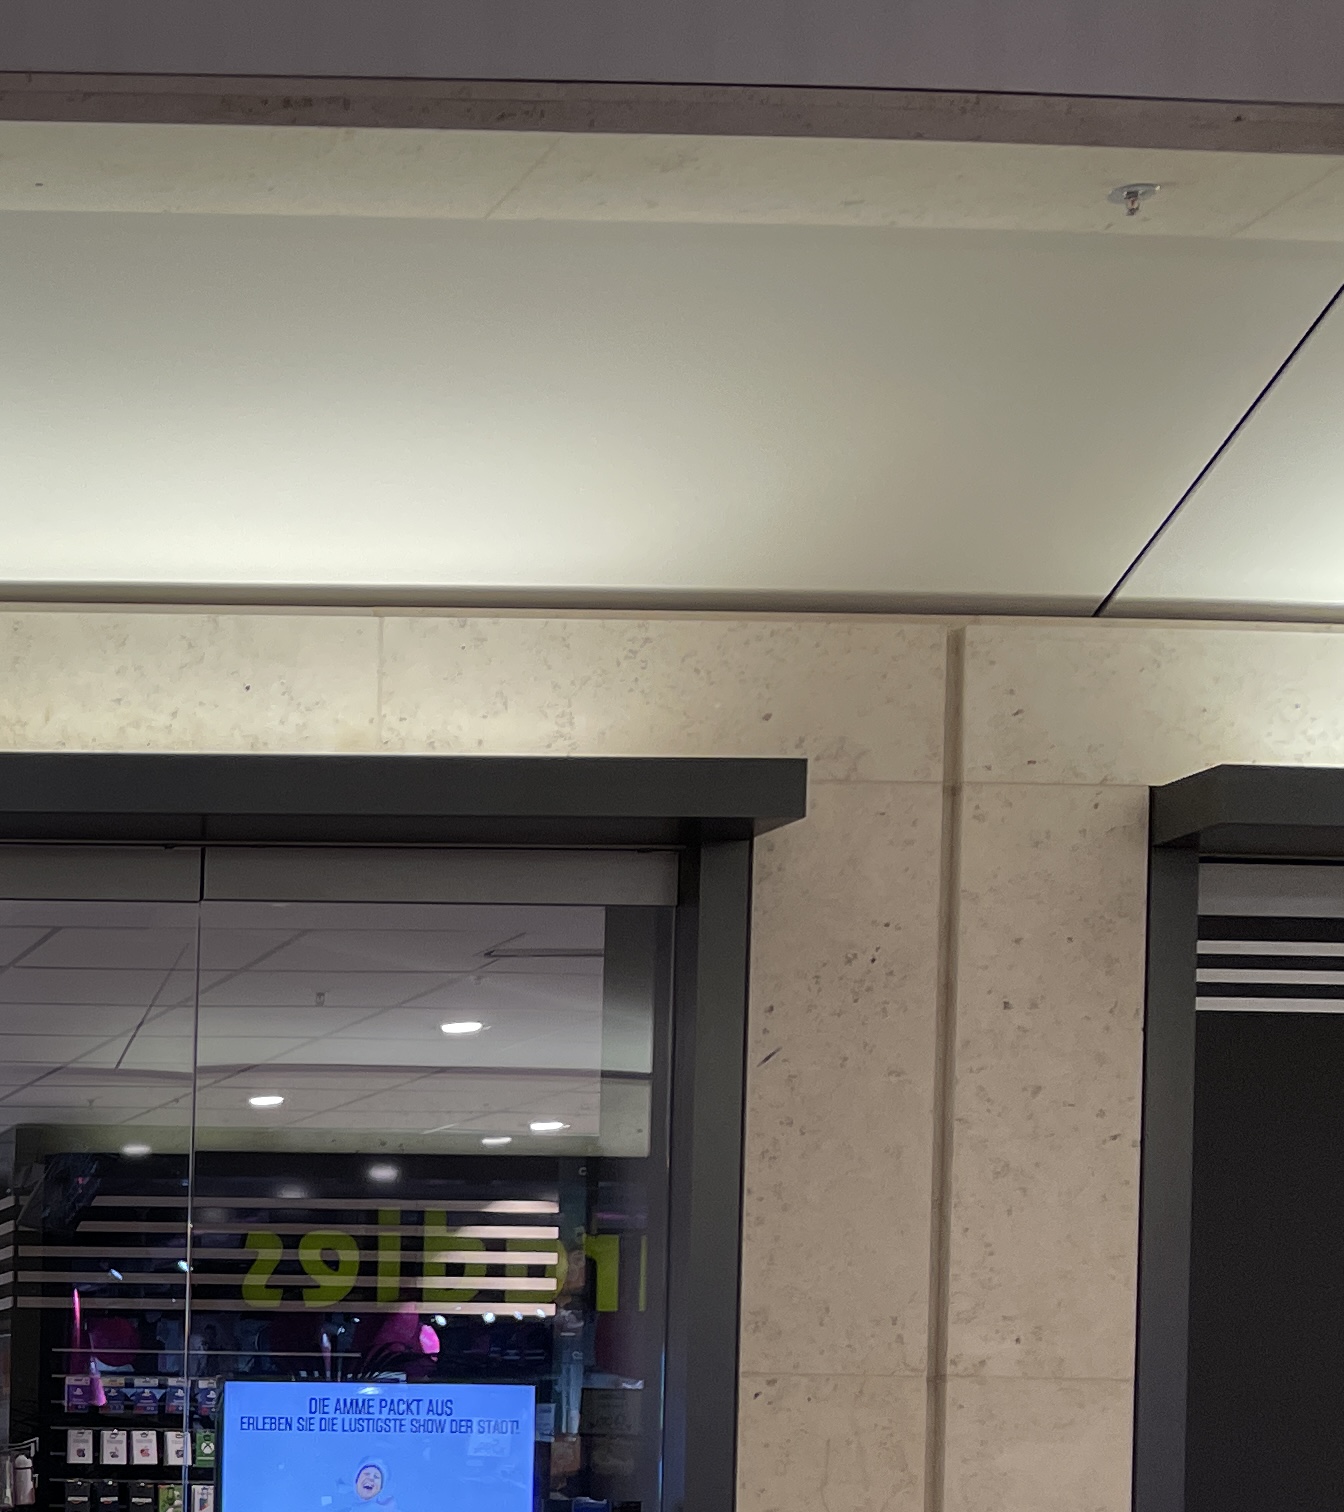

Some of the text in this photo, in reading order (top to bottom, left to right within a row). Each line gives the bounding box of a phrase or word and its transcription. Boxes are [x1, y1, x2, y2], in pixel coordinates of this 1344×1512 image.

[308, 1397, 454, 1417] DIE AMME PACKT AUS
[239, 1416, 293, 1432] ERLEBEN
[296, 1417, 316, 1433] SIE
[318, 1417, 339, 1433] DIE
[341, 1417, 406, 1434] LUSTIGSTE
[410, 1418, 447, 1434] SHOW
[449, 1418, 474, 1434] DER
